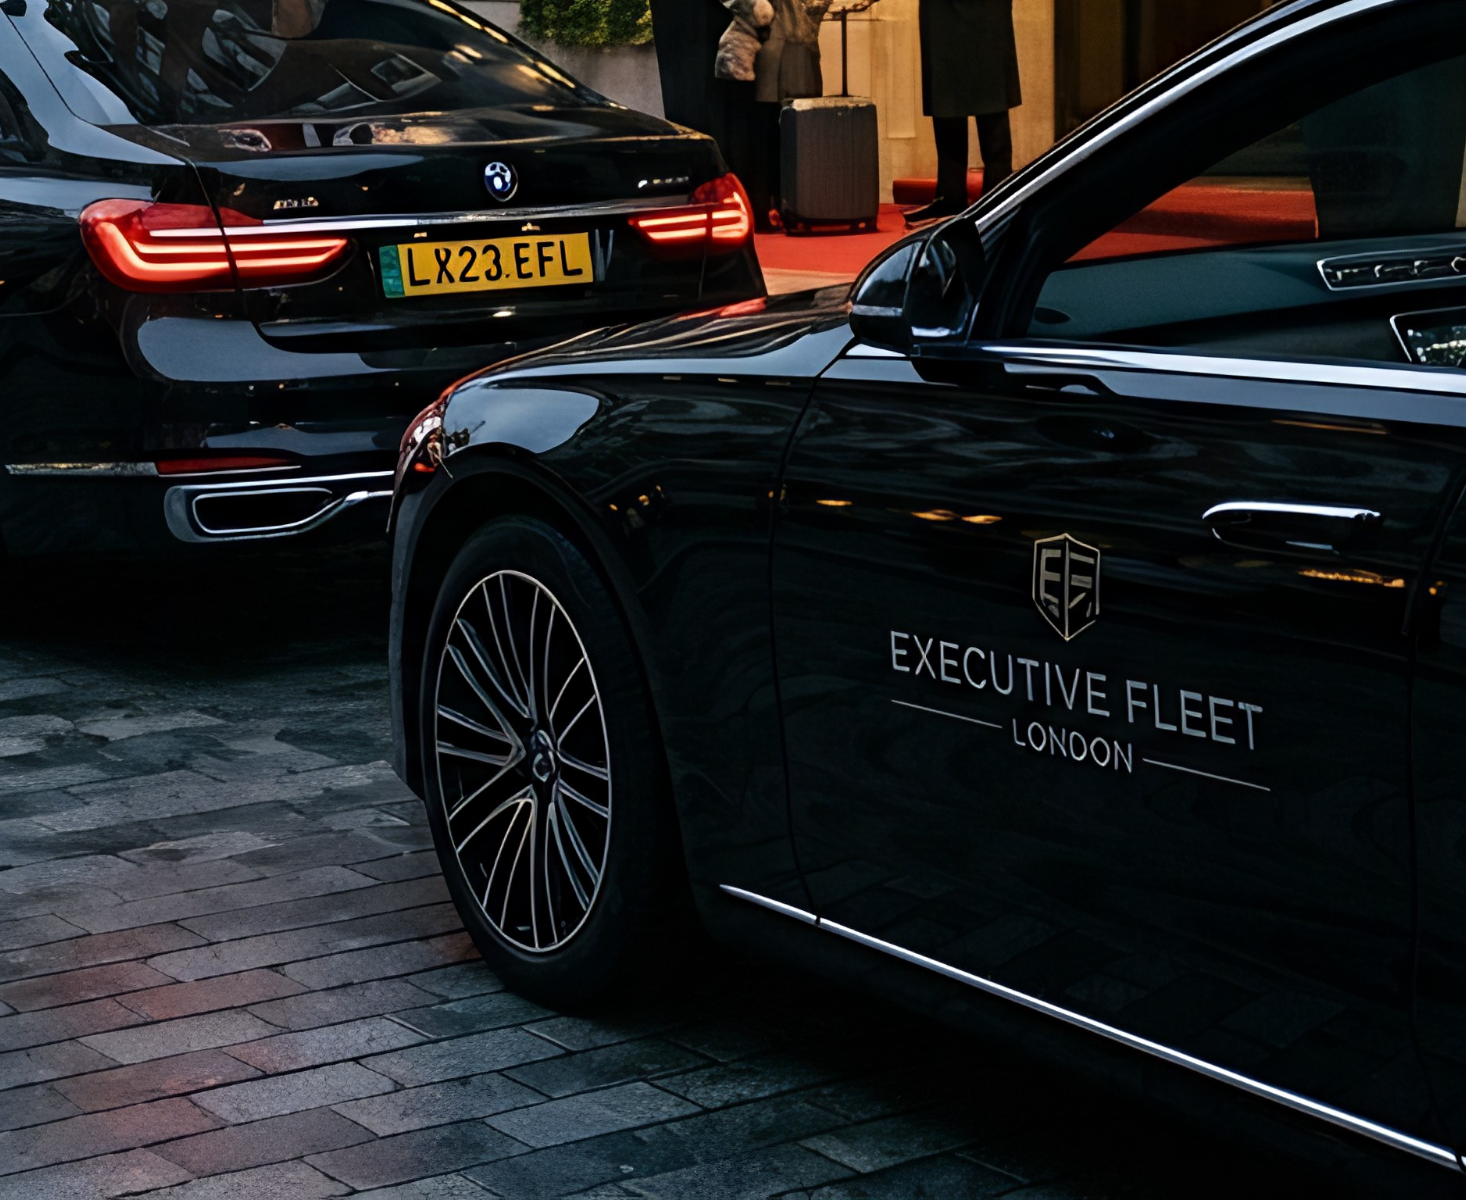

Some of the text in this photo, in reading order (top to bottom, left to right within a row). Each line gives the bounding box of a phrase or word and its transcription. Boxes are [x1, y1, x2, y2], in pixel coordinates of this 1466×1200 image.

[890, 630, 1264, 751] EXECUTIVE FLEET
[1011, 717, 1133, 774] LONDON
